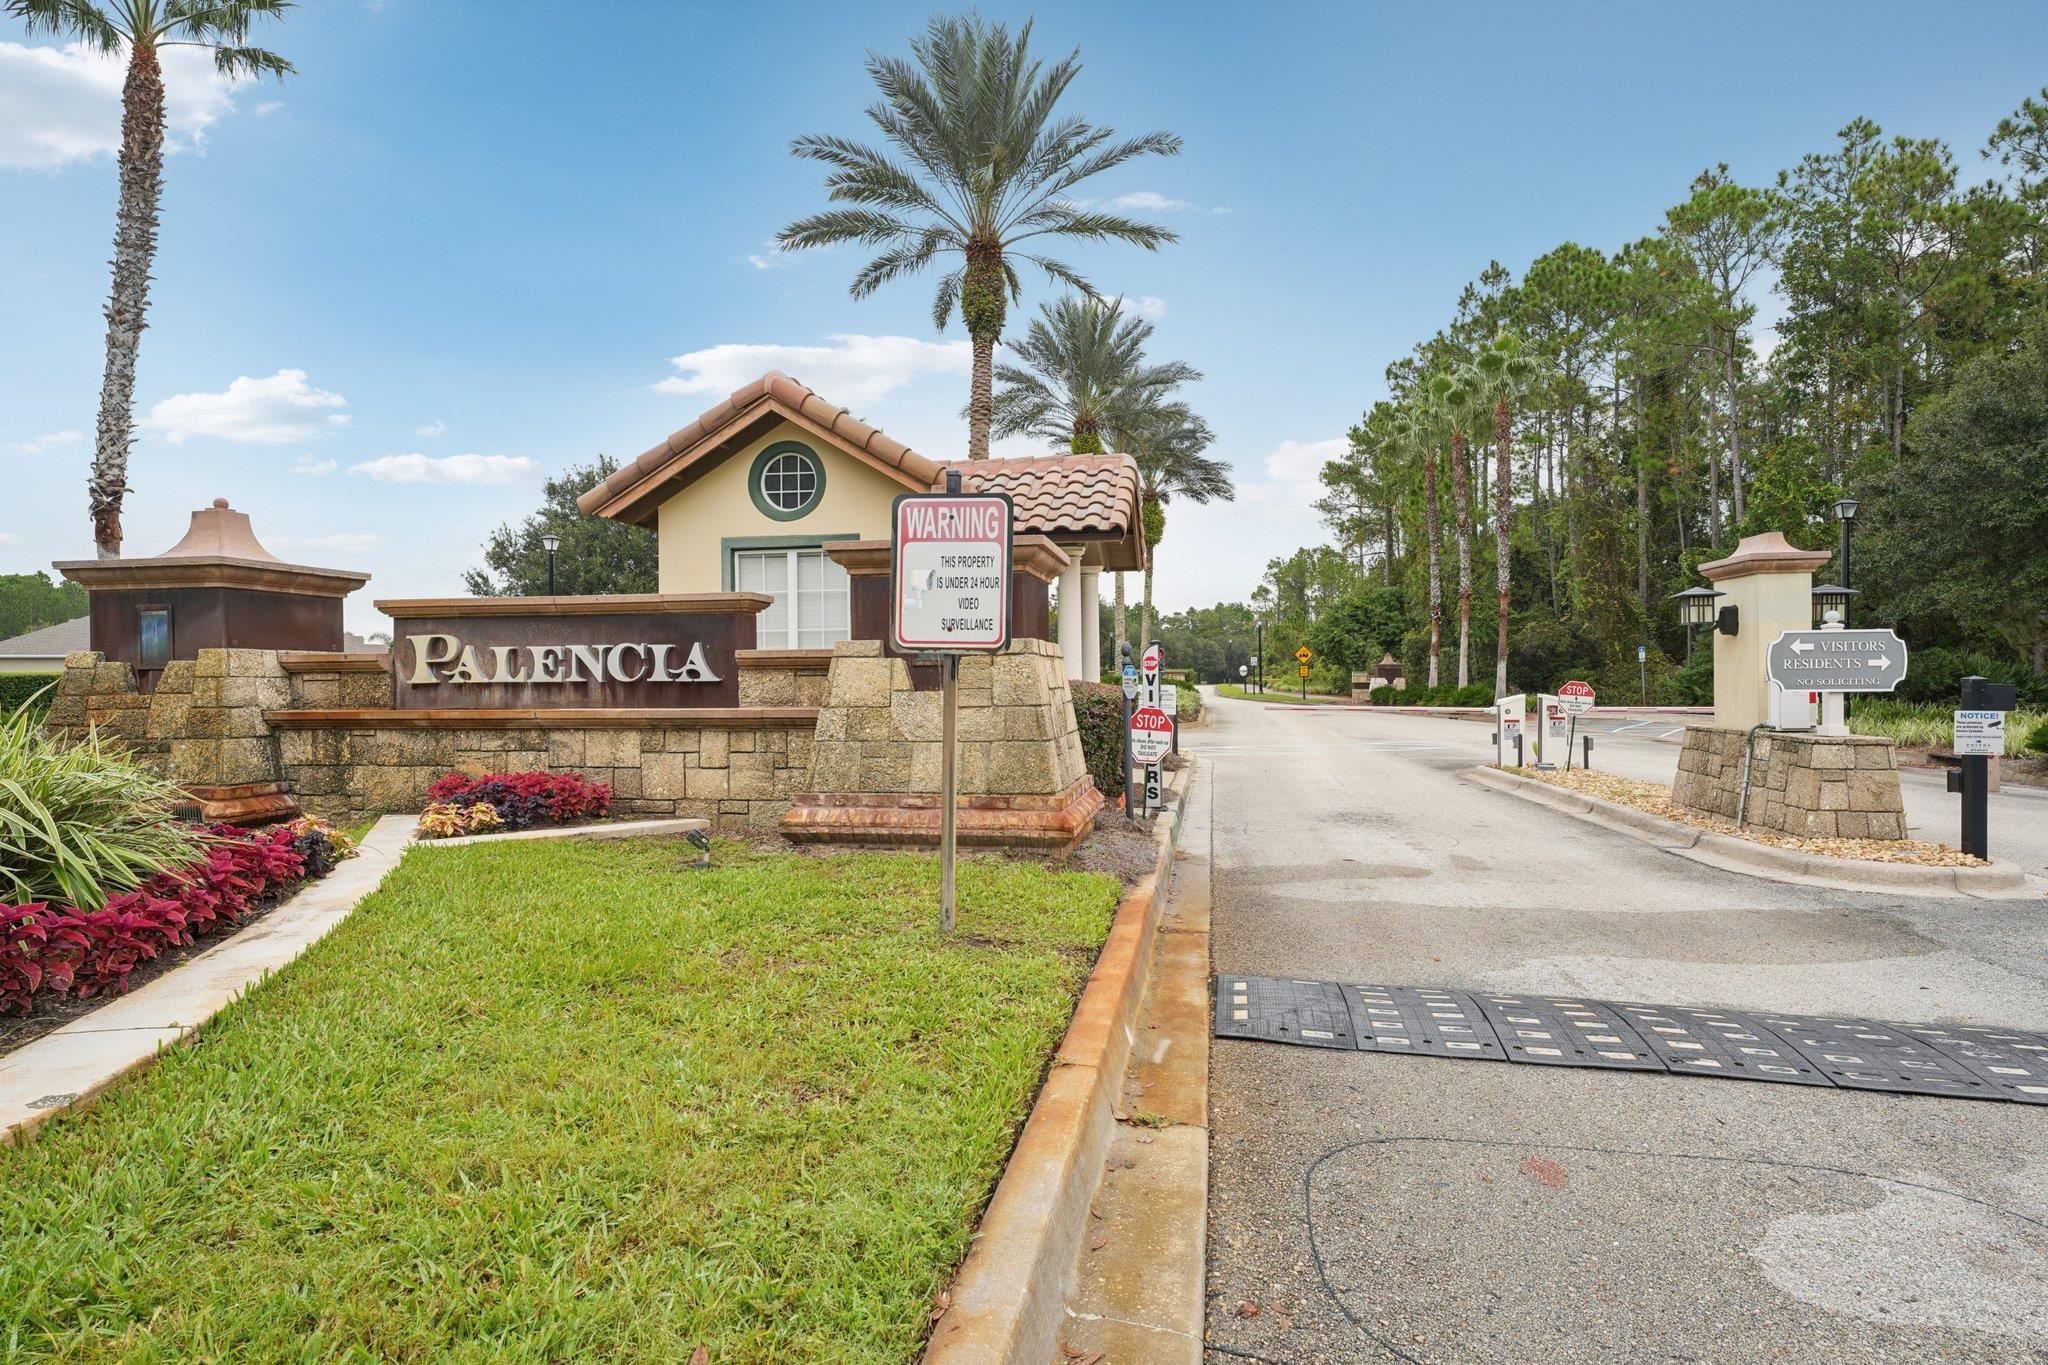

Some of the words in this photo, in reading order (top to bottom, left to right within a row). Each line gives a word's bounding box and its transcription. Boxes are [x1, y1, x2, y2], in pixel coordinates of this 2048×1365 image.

[906, 506, 999, 539] WARNING
[941, 556, 956, 568] THIS
[957, 556, 995, 568] PROPERTY
[936, 577, 944, 588] IS
[945, 577, 969, 589] UNDER
[970, 577, 978, 588] 24
[979, 577, 1000, 589] HOUR
[958, 597, 980, 609] VIDEO
[941, 618, 994, 631] SURVEILLANCE
[1821, 640, 1886, 652] VISITORS
[406, 634, 723, 684] PALENCIA
[1783, 658, 1862, 670] RESIDENTS
[1797, 678, 1813, 686] NO
[1816, 677, 1880, 686] SOLICITING
[1566, 685, 1588, 695] STOP
[1136, 714, 1166, 729] STOP
